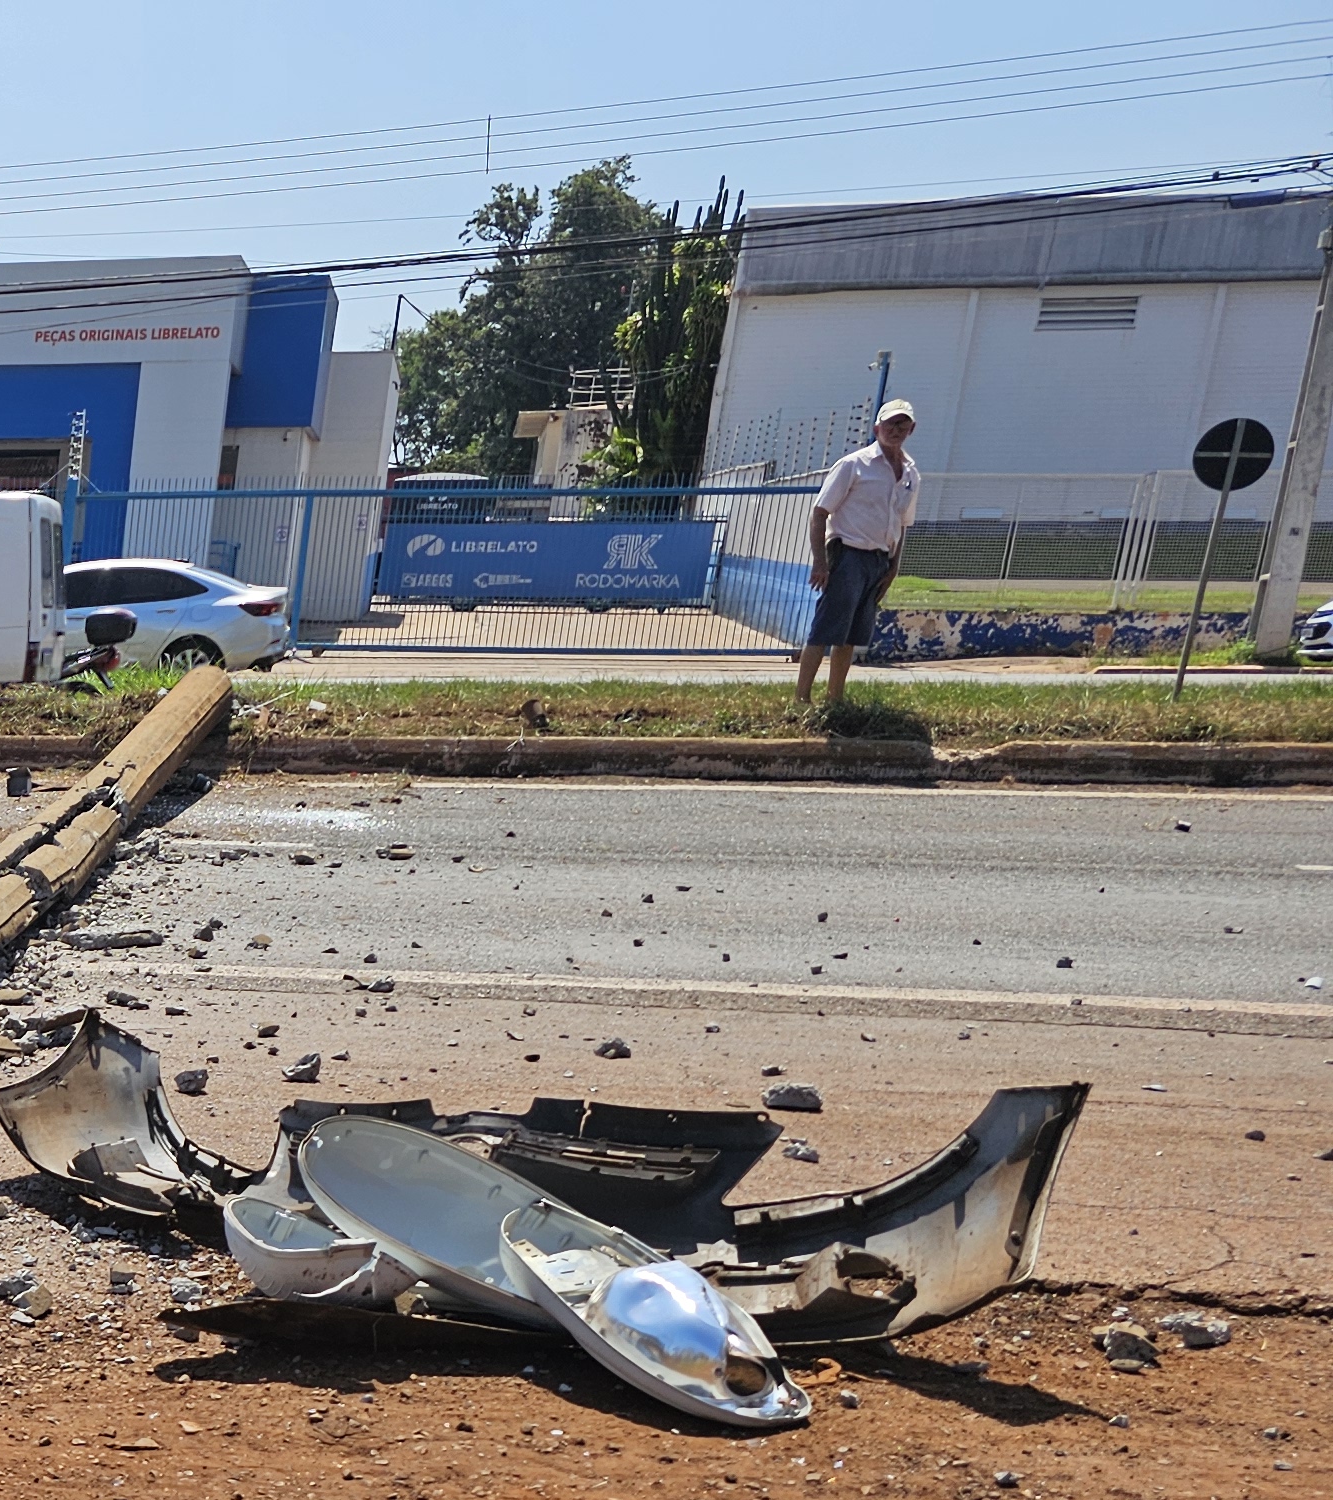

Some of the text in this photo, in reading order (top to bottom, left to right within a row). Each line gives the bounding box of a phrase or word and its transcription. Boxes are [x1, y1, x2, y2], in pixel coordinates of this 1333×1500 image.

[34, 326, 220, 346] PEÇAS ORIGINAIS LIBRELATO
[450, 540, 538, 553] LIBRELATO
[575, 573, 680, 589] RODOMARKA
